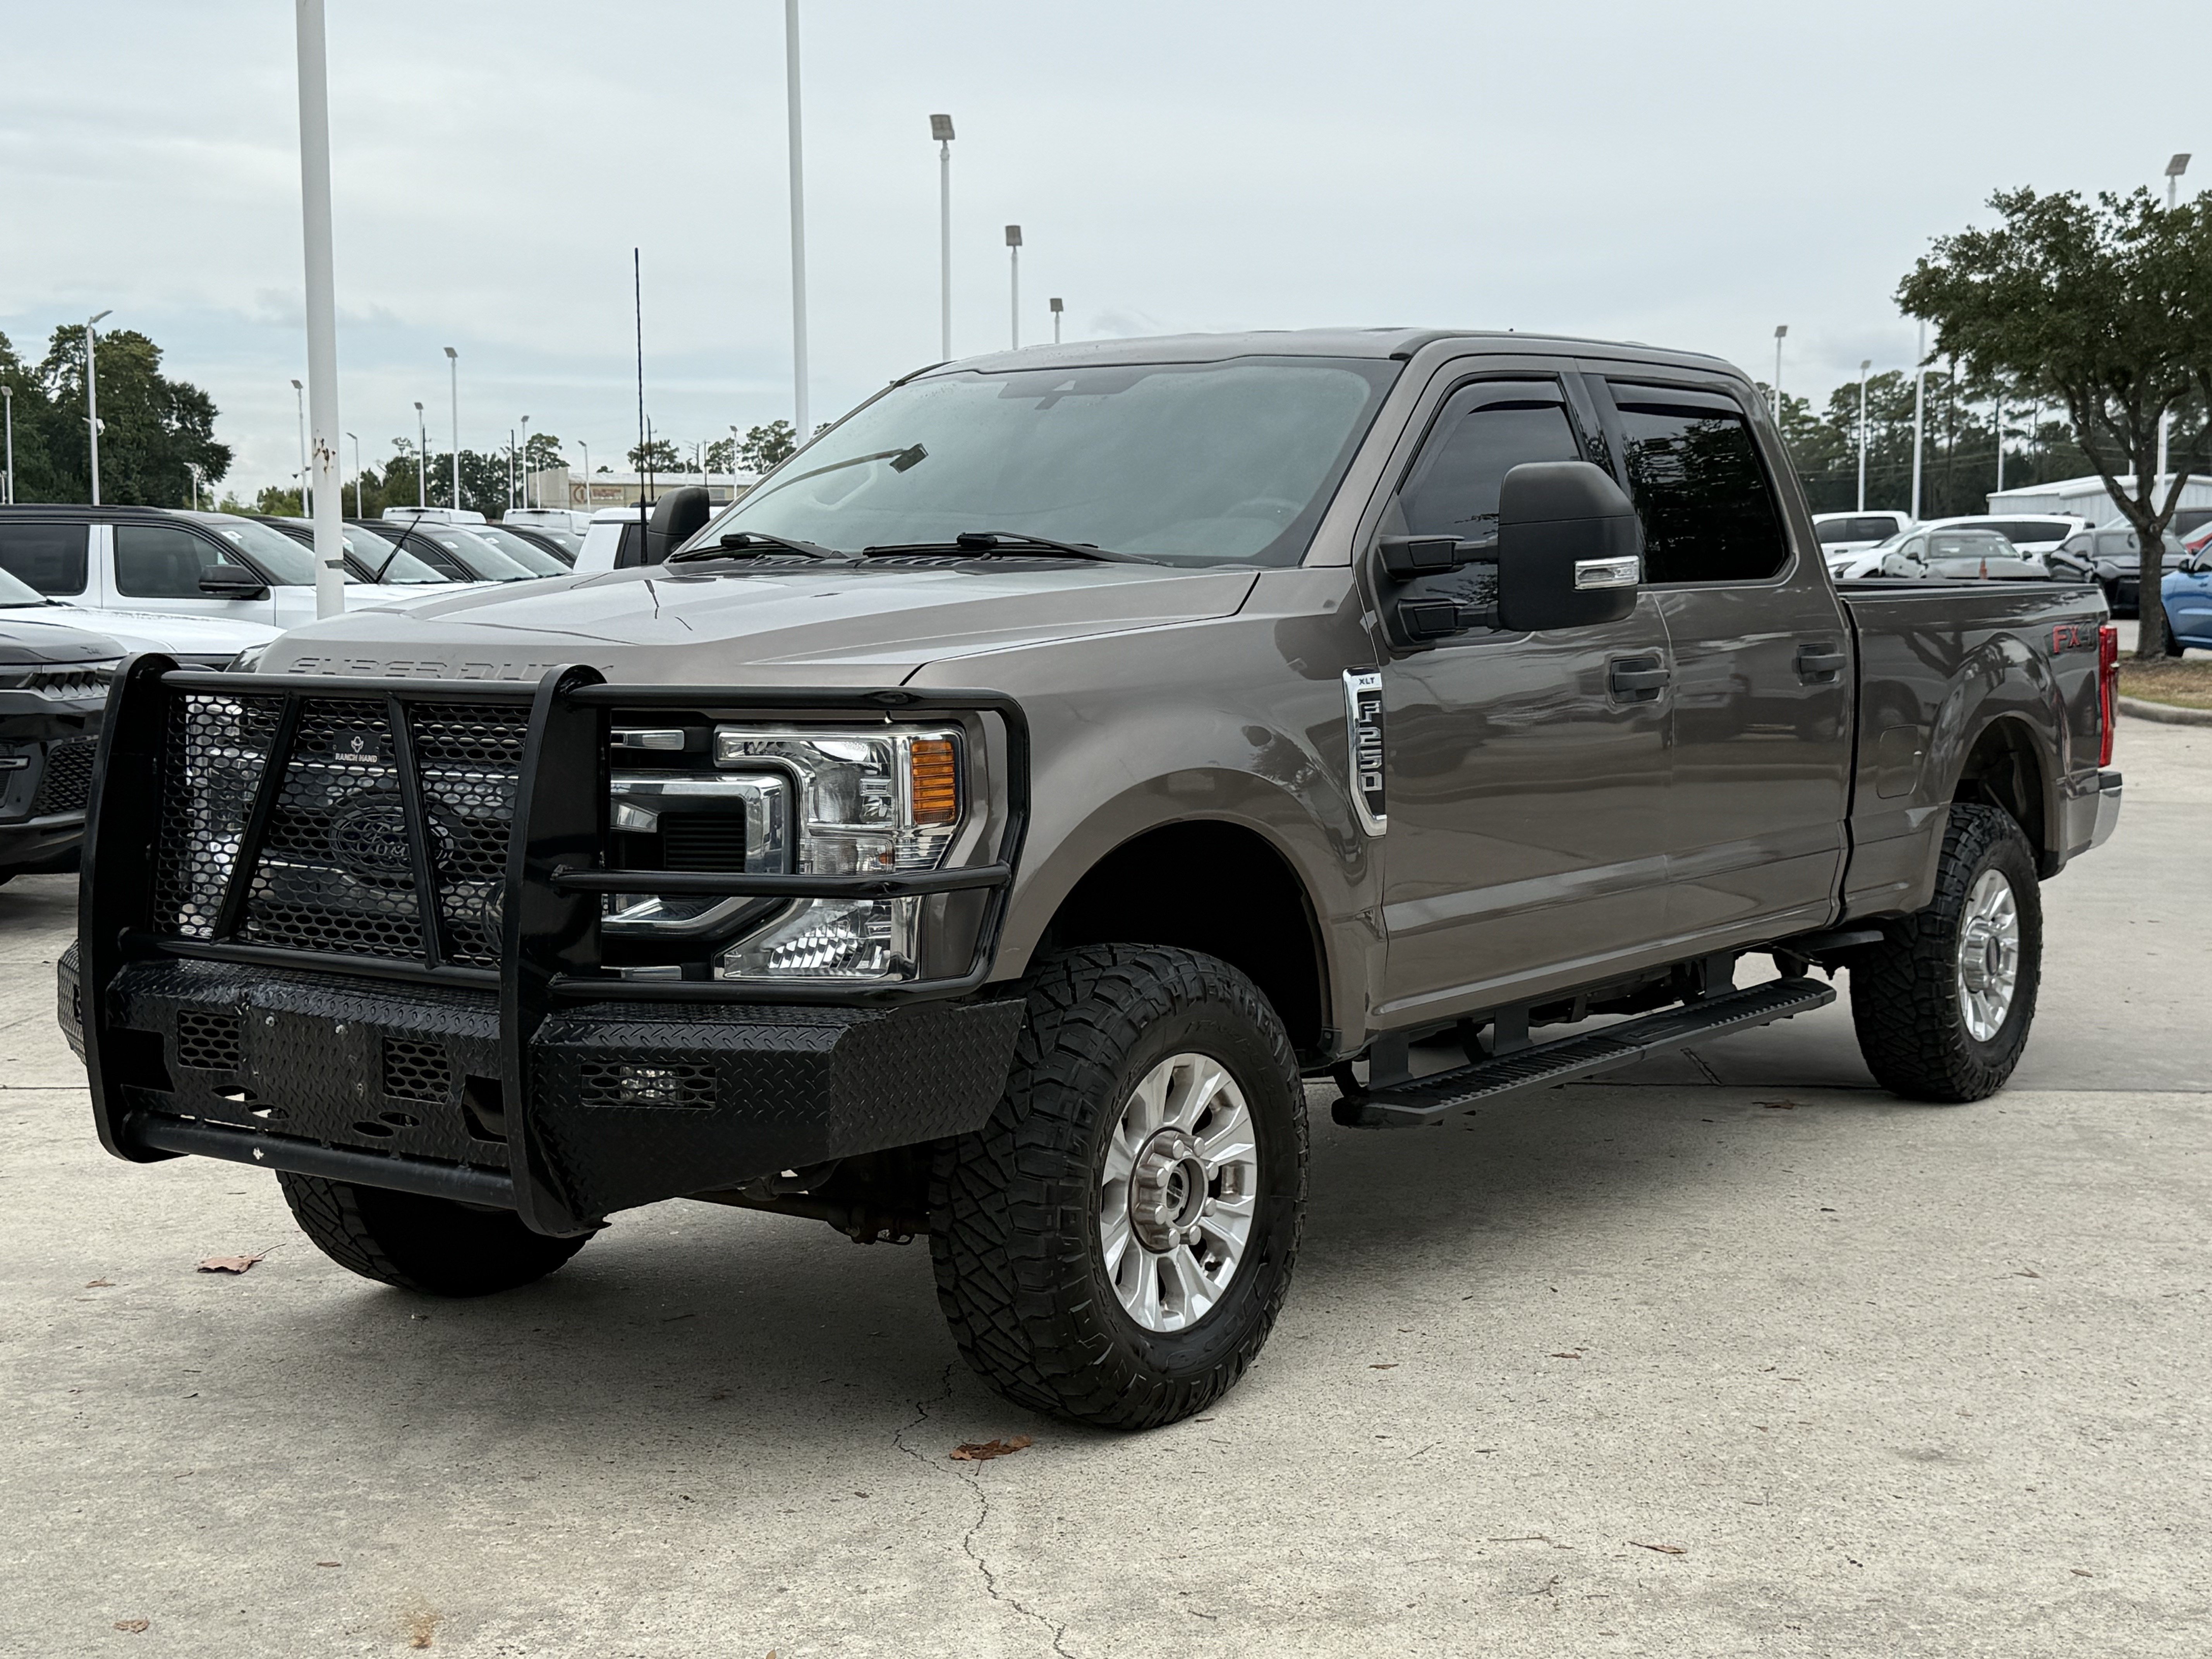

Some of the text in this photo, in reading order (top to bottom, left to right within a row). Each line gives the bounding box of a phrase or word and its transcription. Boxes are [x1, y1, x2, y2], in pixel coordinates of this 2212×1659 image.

[289, 657, 448, 679] SUPER
[1358, 677, 1374, 685] XLT
[335, 752, 378, 763] RANCH HAND
